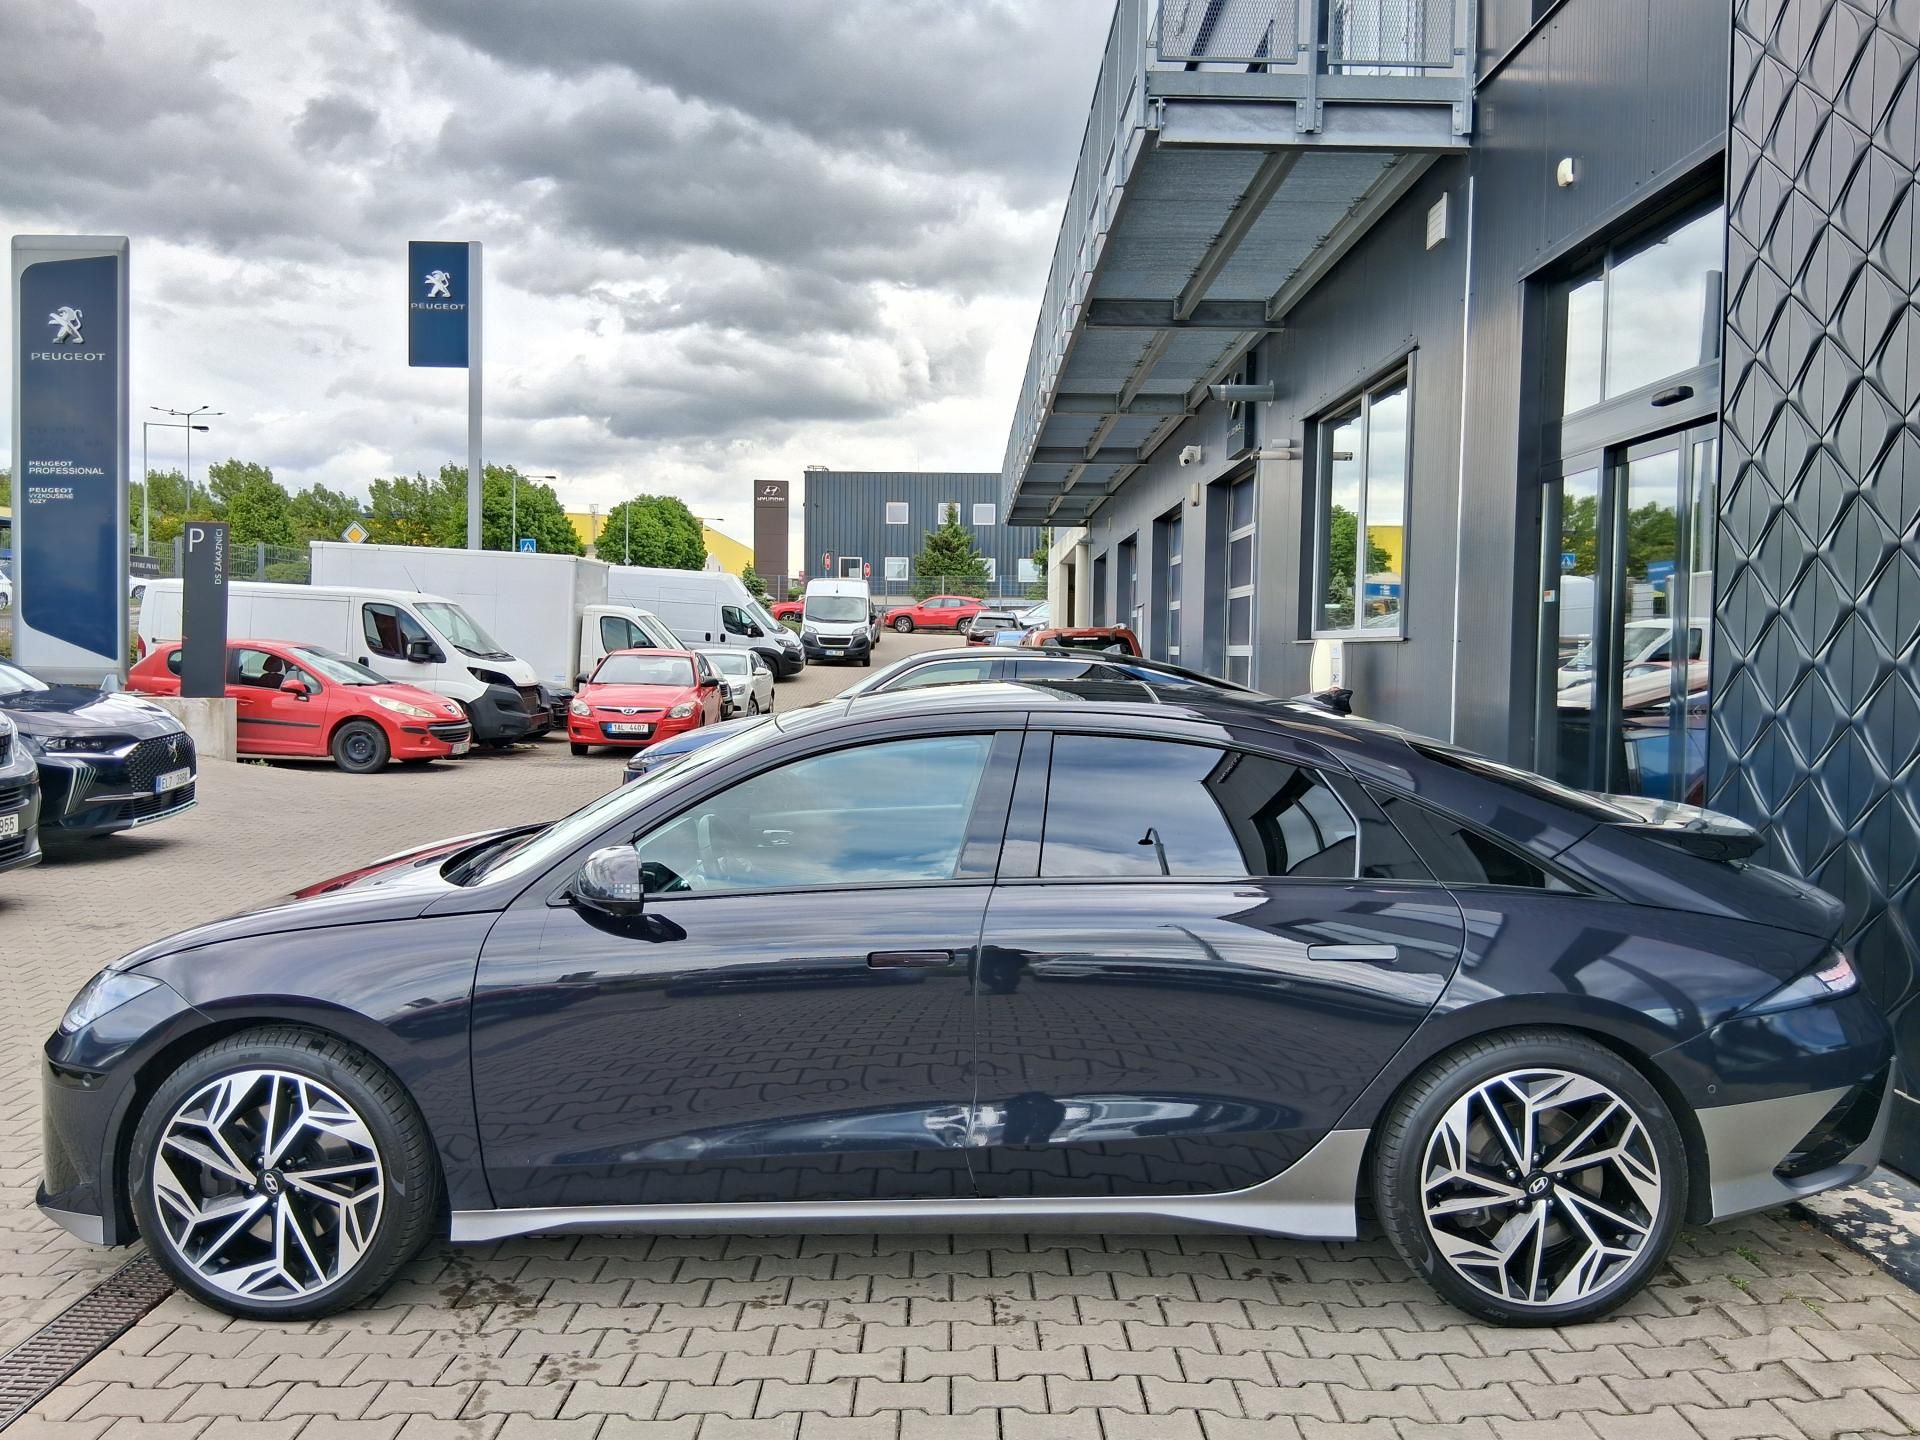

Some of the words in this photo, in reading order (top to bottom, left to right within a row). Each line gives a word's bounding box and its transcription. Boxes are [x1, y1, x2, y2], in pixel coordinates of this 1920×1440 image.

[30, 352, 106, 361] PEUGEOT
[28, 467, 105, 475] PROFESSIONAL
[189, 528, 205, 552] P
[214, 573, 222, 585] DS
